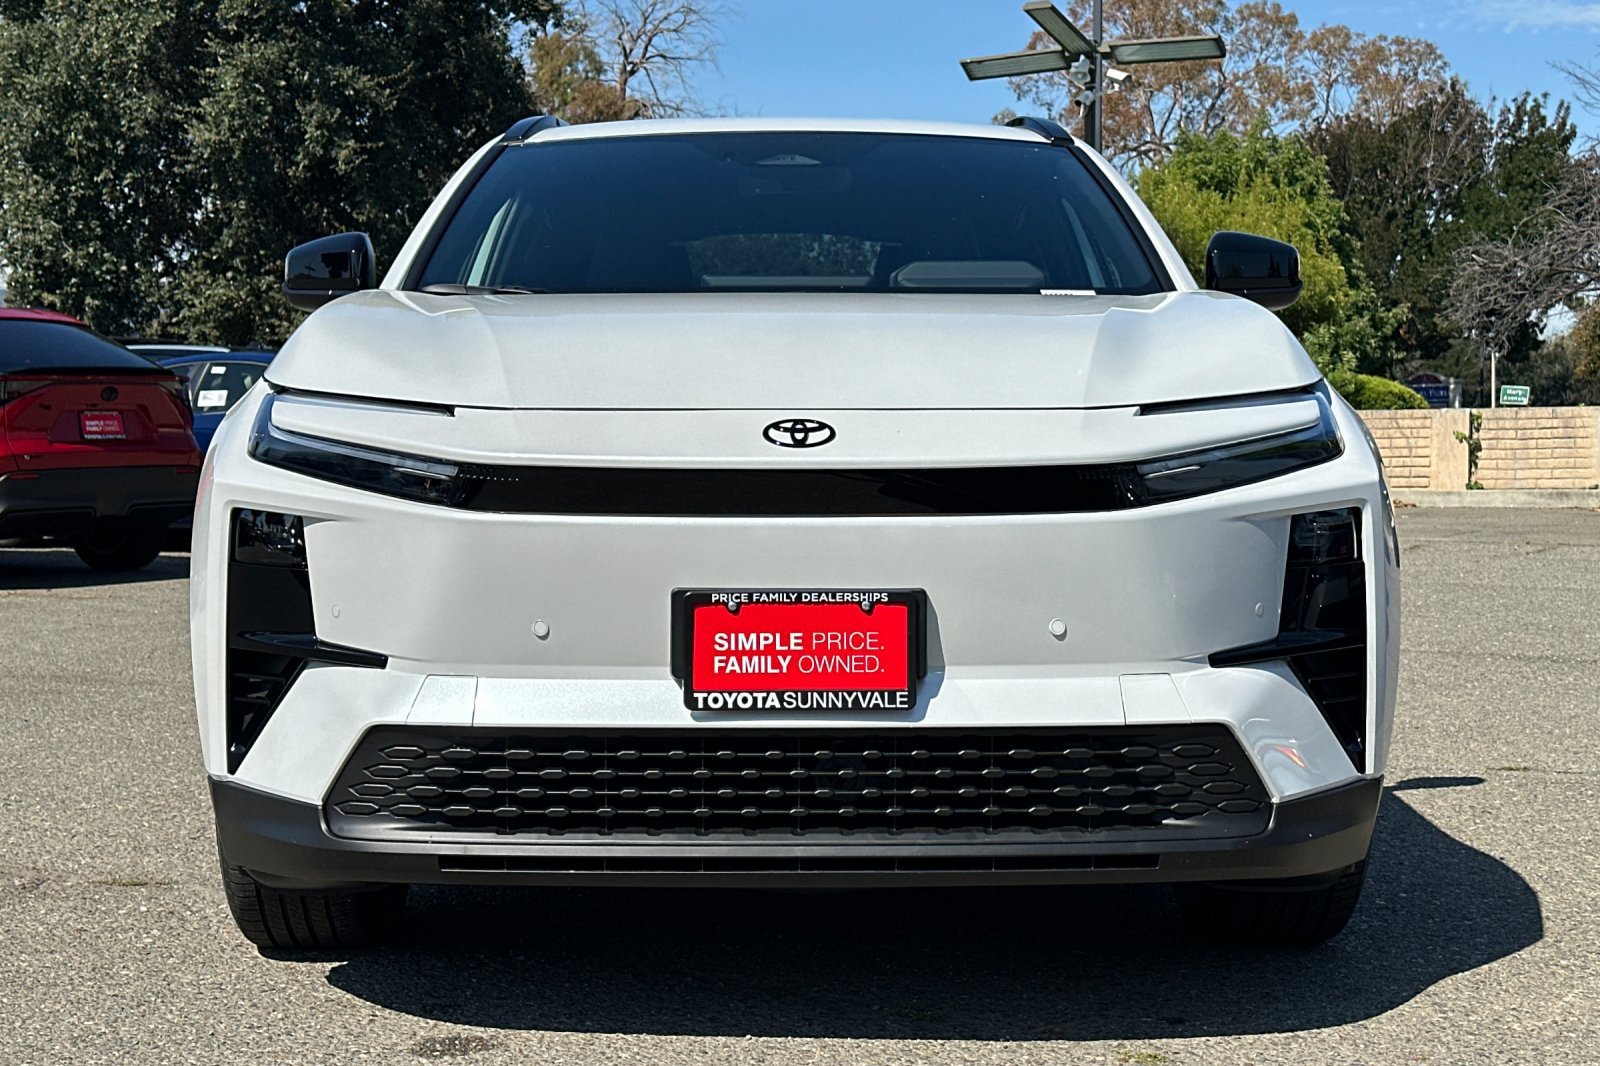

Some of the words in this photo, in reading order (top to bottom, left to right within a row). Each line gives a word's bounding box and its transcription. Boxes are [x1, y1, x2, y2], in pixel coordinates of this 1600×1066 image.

[711, 593, 749, 603] PRICE
[752, 593, 798, 602] FAMILY
[801, 592, 889, 602] DEALERSHIPS
[713, 632, 804, 651] SIMPLE
[812, 631, 885, 650] PRICE.
[713, 655, 792, 674] FAMILY
[798, 655, 885, 673] OWNED.
[693, 692, 781, 709] TOYOTA
[783, 691, 909, 708] SUNNYVALE
